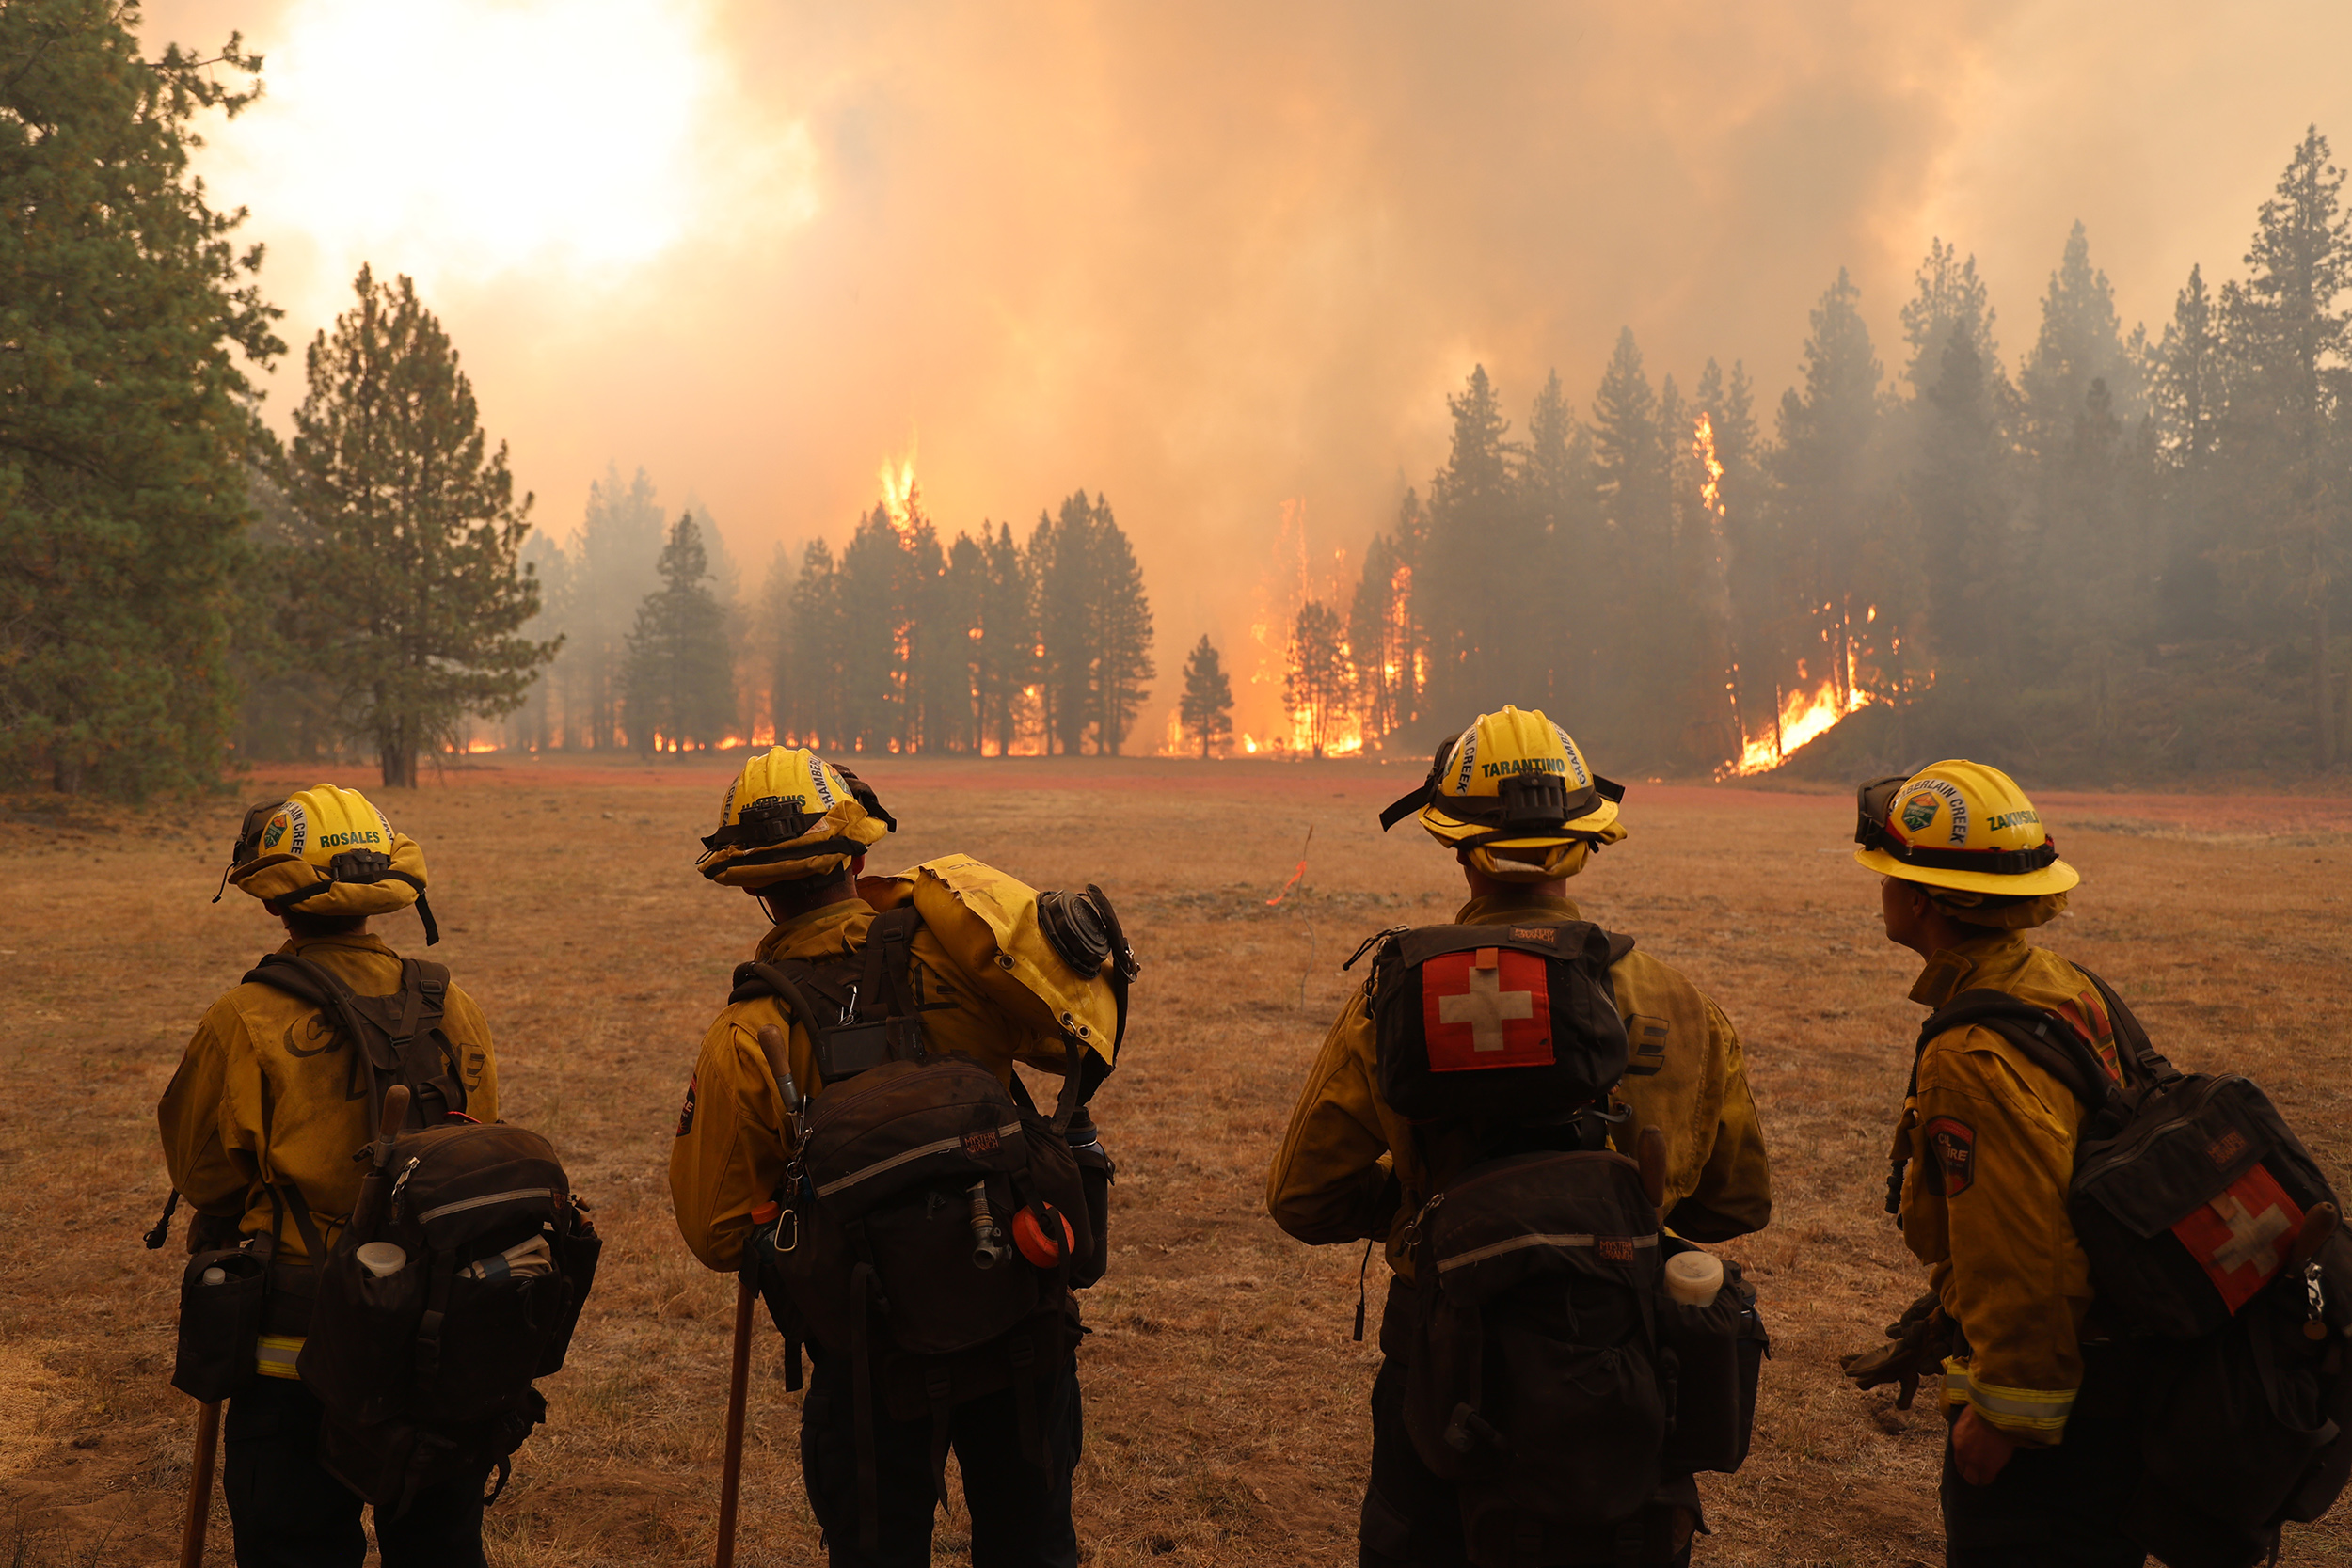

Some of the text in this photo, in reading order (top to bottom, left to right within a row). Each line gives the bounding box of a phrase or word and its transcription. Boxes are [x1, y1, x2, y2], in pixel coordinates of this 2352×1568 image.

[1457, 747, 1475, 793] CREEK
[1482, 758, 1565, 778] TARANTINO
[1949, 798, 1967, 844] CREEK
[291, 823, 305, 854] CREE
[320, 832, 380, 848] ROSALES
[964, 1132, 996, 1147] MYSTERY
